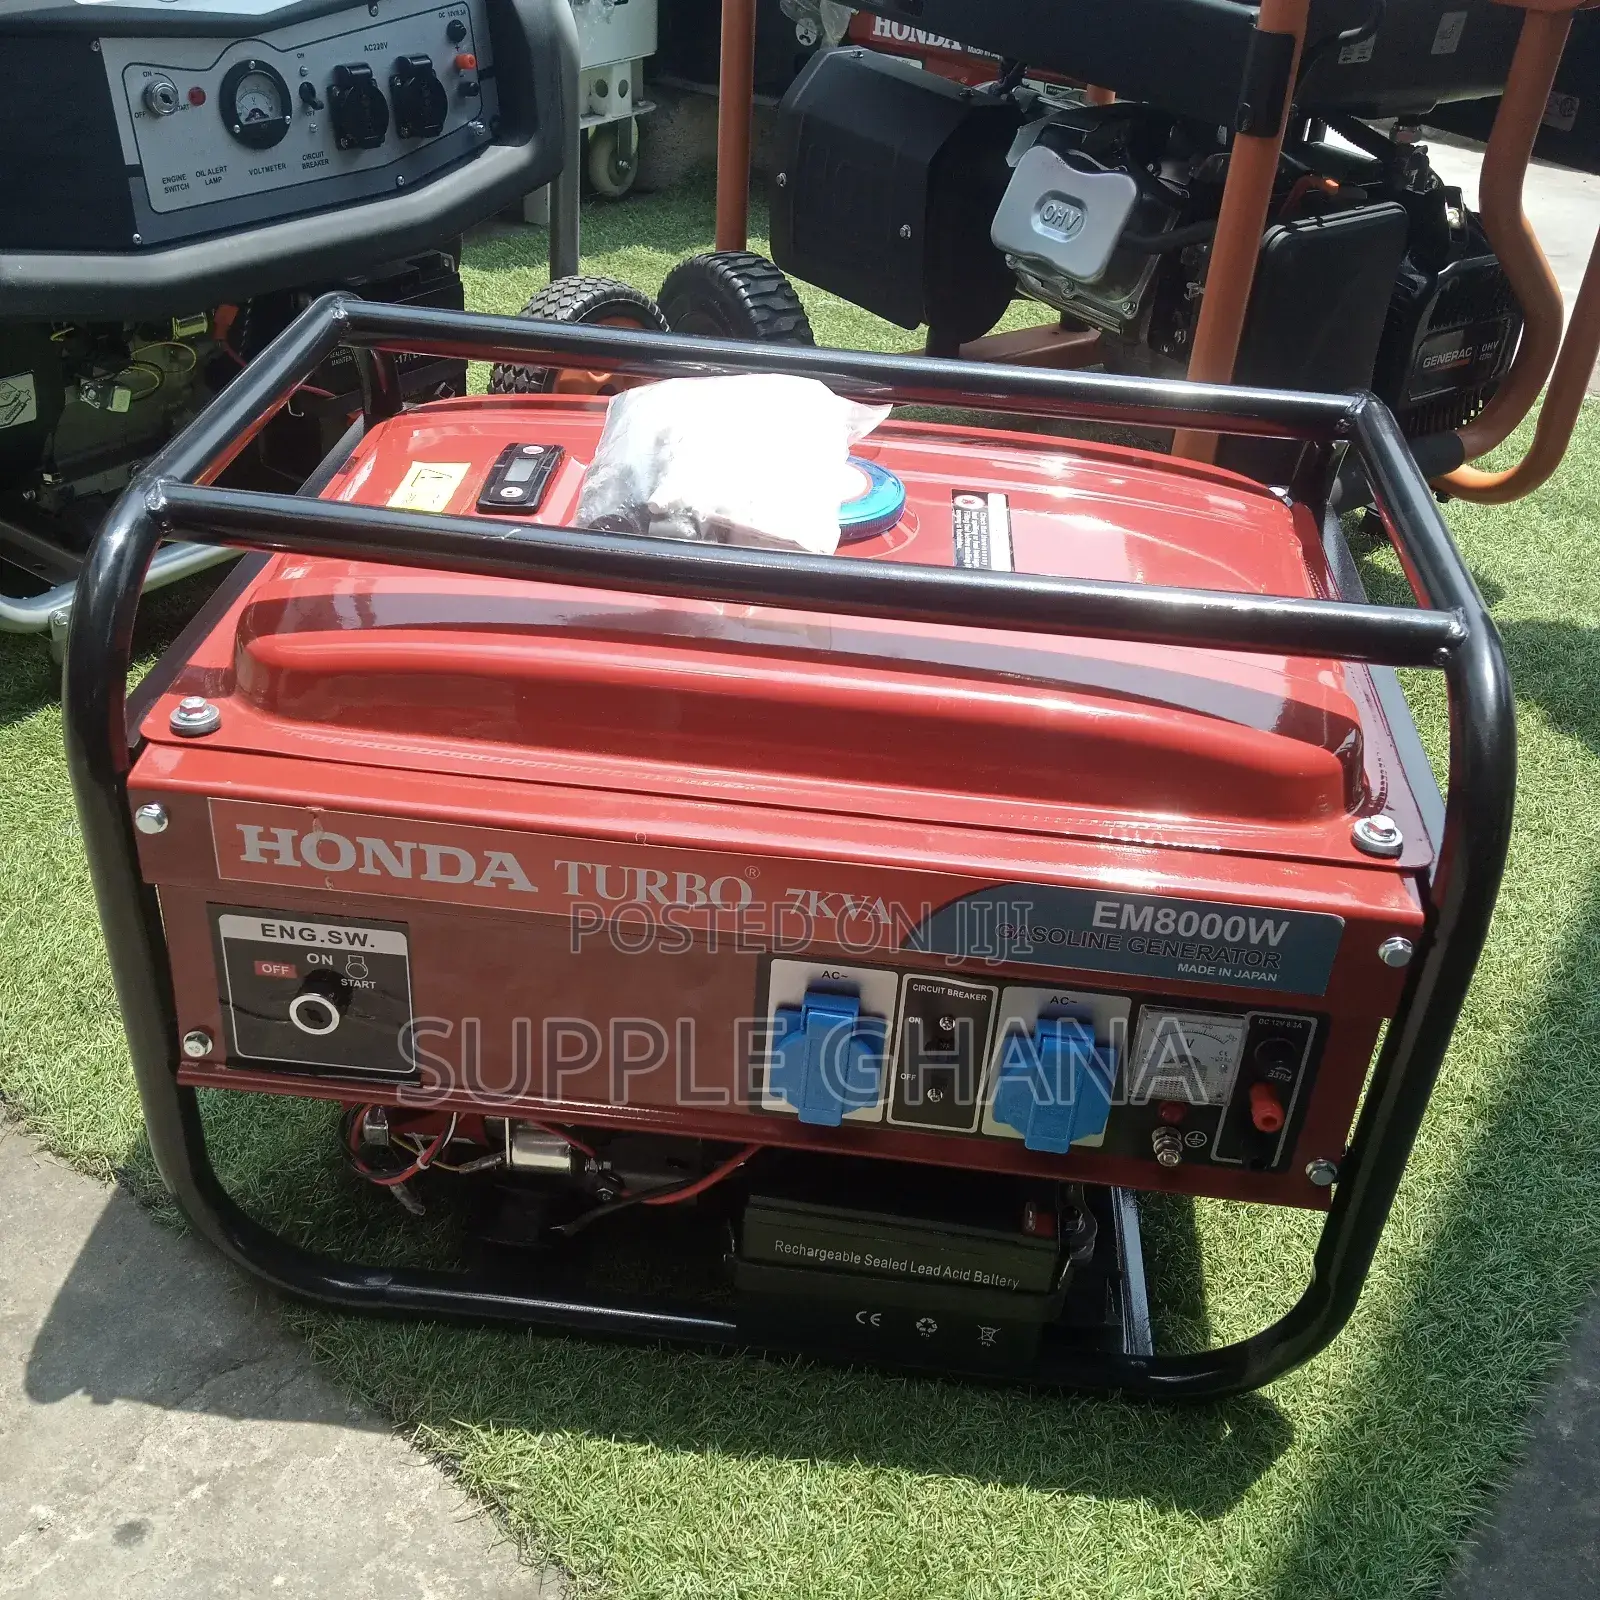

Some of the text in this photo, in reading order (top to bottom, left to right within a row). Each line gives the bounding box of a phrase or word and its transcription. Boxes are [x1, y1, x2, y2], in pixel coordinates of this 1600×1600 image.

[363, 41, 388, 52] AC220V
[134, 111, 146, 119] OFF
[302, 151, 325, 161] CIRCUIT
[247, 162, 287, 176] VOLTMETER
[301, 158, 330, 170] BREAKER
[195, 165, 228, 178] OIL ALERT
[161, 173, 187, 185] ENGINE
[204, 176, 223, 186] LAMP
[163, 182, 190, 194] SWITCH
[1042, 202, 1082, 231] OHV
[1481, 340, 1500, 352] OHV
[330, 355, 353, 367] MAINTEN
[1422, 346, 1473, 369] GENERAC
[235, 823, 539, 893] HONDA
[784, 887, 894, 926] 7KVA
[1091, 899, 1290, 948] EM8000W
[260, 922, 376, 949] ENG.SW.
[995, 922, 1282, 970] GASOLINE GENERATOR
[306, 952, 334, 966] ON
[261, 963, 290, 975] OFF
[1176, 962, 1278, 983] MADE IN JAPAN
[340, 978, 377, 990] START
[912, 983, 988, 1002] CIRCUIT BREAKER
[908, 1016, 921, 1025] ON
[1258, 1018, 1271, 1026] DC
[900, 1072, 917, 1081] OFF
[1267, 1069, 1293, 1083] FUSE
[774, 1239, 1020, 1291] Rechargeable Sealed Lead Acid Battery
